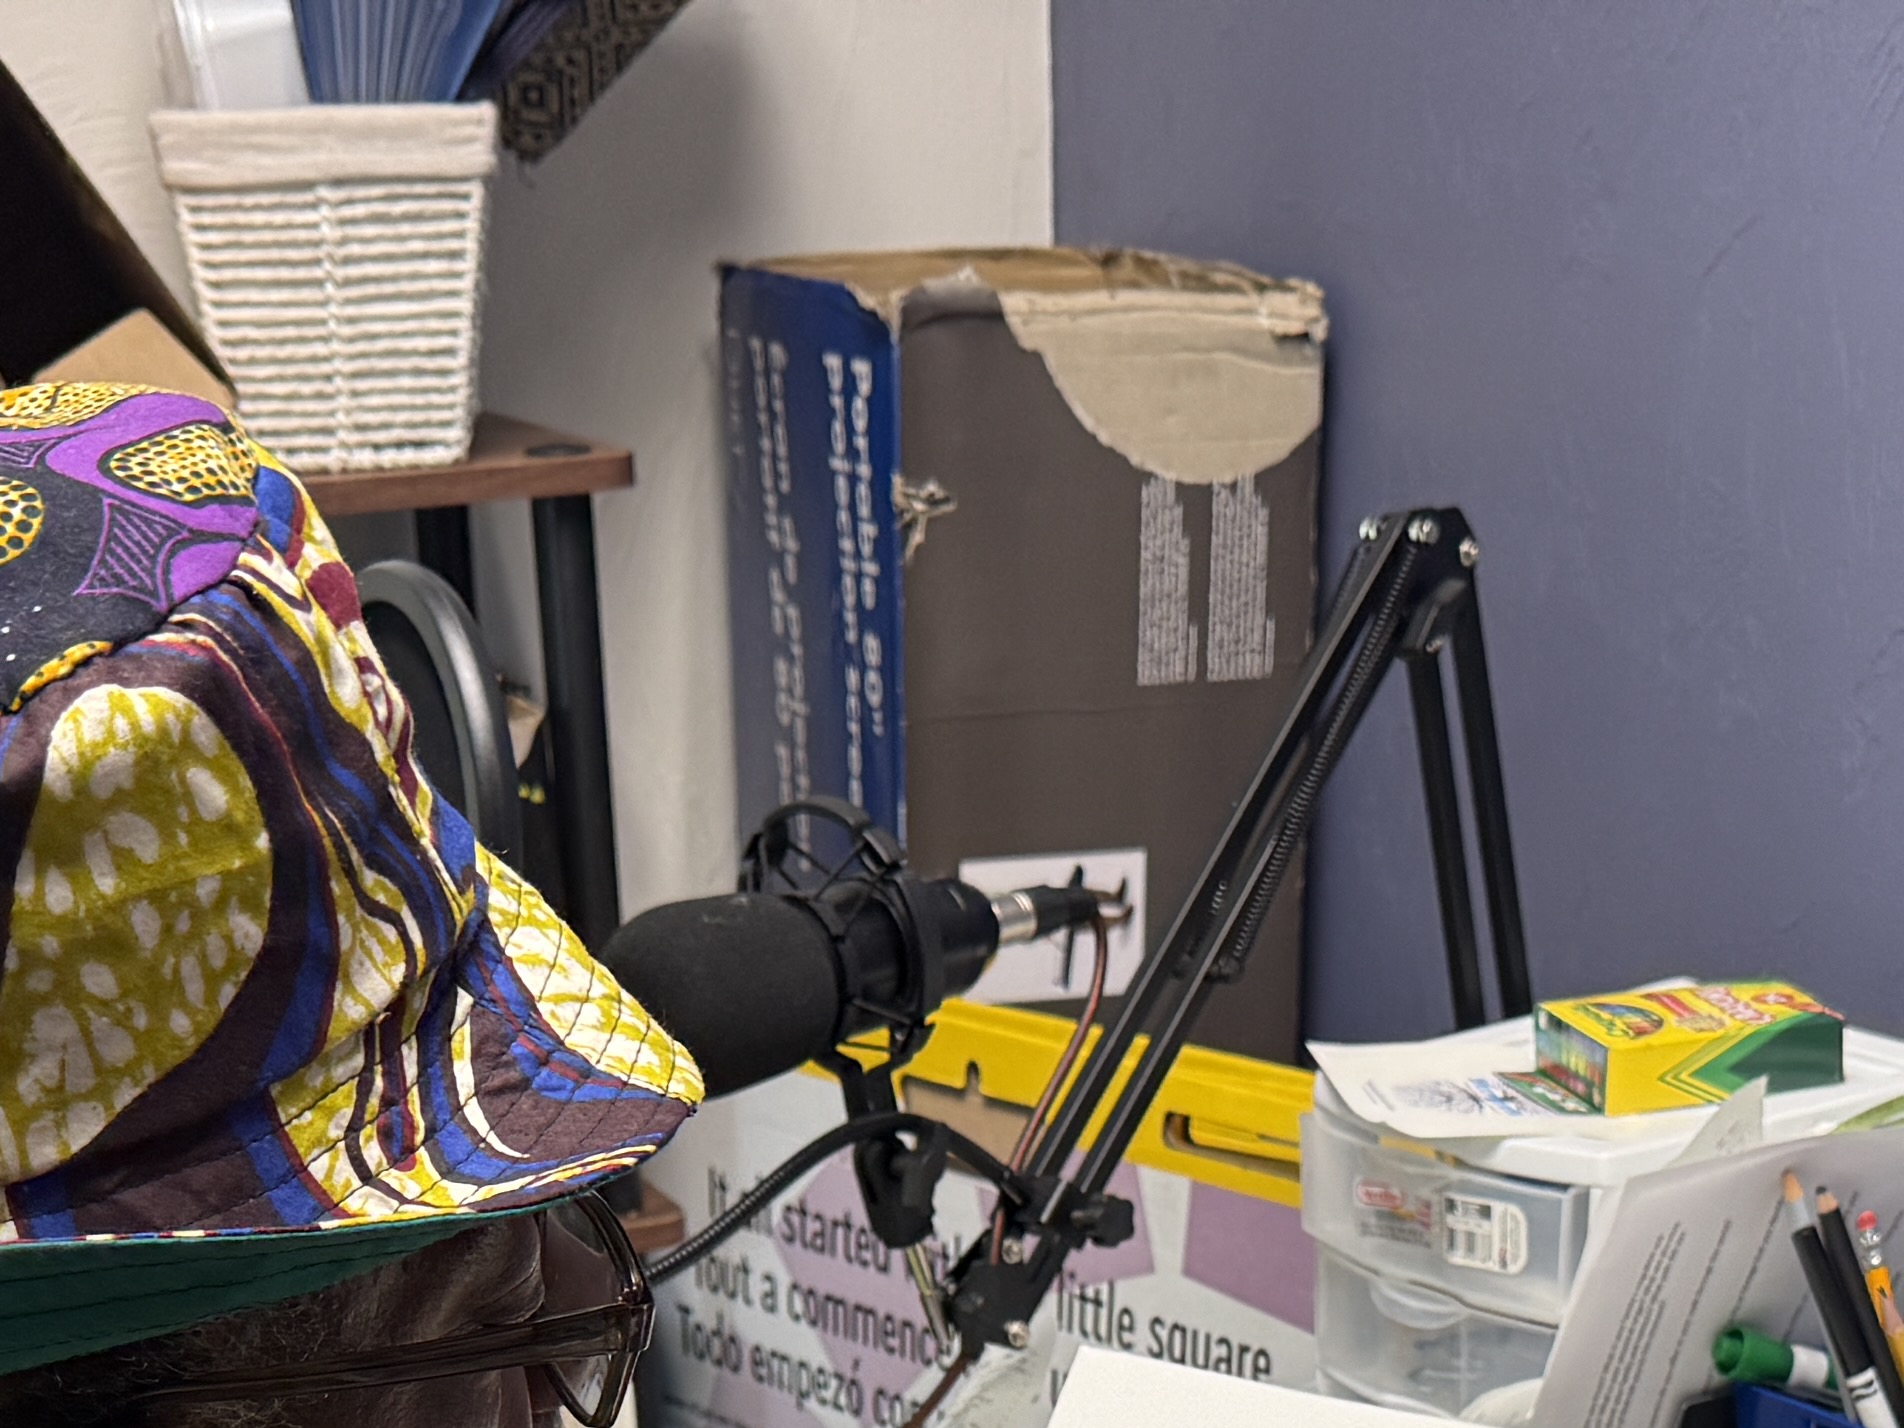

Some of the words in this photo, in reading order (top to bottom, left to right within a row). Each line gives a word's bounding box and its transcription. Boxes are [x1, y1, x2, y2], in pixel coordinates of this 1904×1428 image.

[851, 356, 881, 610] Portable
[823, 353, 859, 645] projection
[845, 664, 864, 808] scree
[761, 1270, 778, 1313] a
[1055, 1271, 1135, 1350] little
[678, 1303, 743, 1373] Todo
[751, 1342, 863, 1418] empezó
